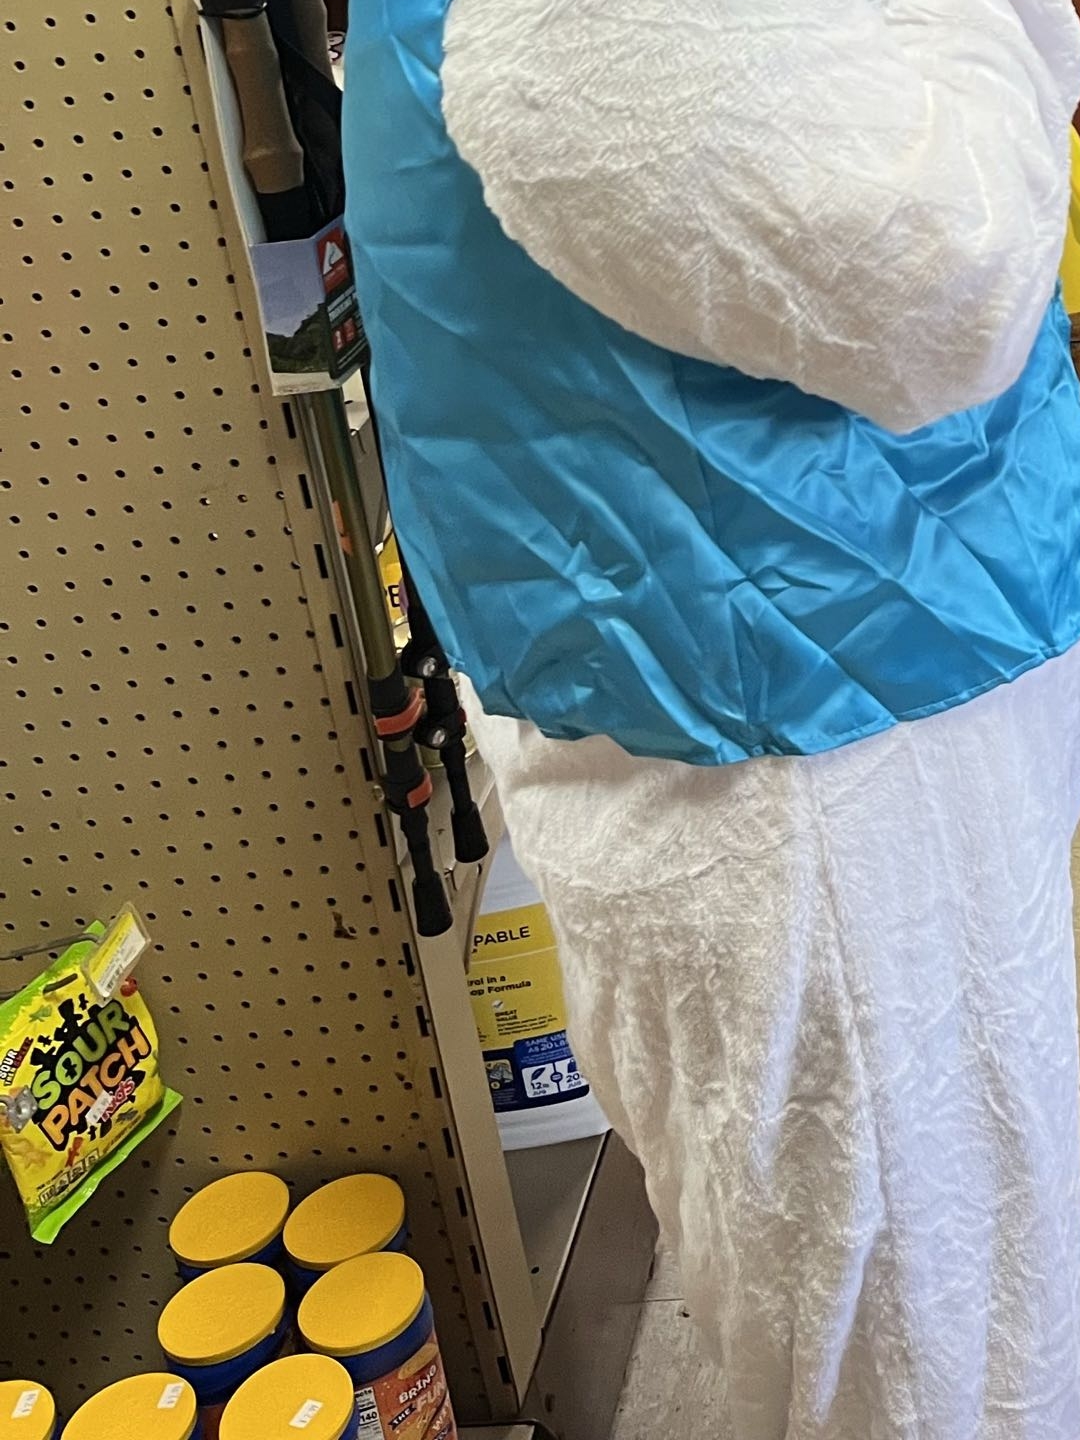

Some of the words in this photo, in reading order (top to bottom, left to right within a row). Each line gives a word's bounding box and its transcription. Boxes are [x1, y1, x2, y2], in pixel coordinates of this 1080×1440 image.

[486, 976, 498, 984] in
[487, 980, 532, 994] Formula
[540, 1041, 554, 1052] 20
[32, 1001, 130, 1110] SOUR
[0, 1048, 18, 1080] SOUR
[566, 1072, 580, 1083] 20
[41, 1026, 150, 1145] PATCH
[361, 1411, 377, 1423] 140
[393, 1408, 411, 1425] THE
